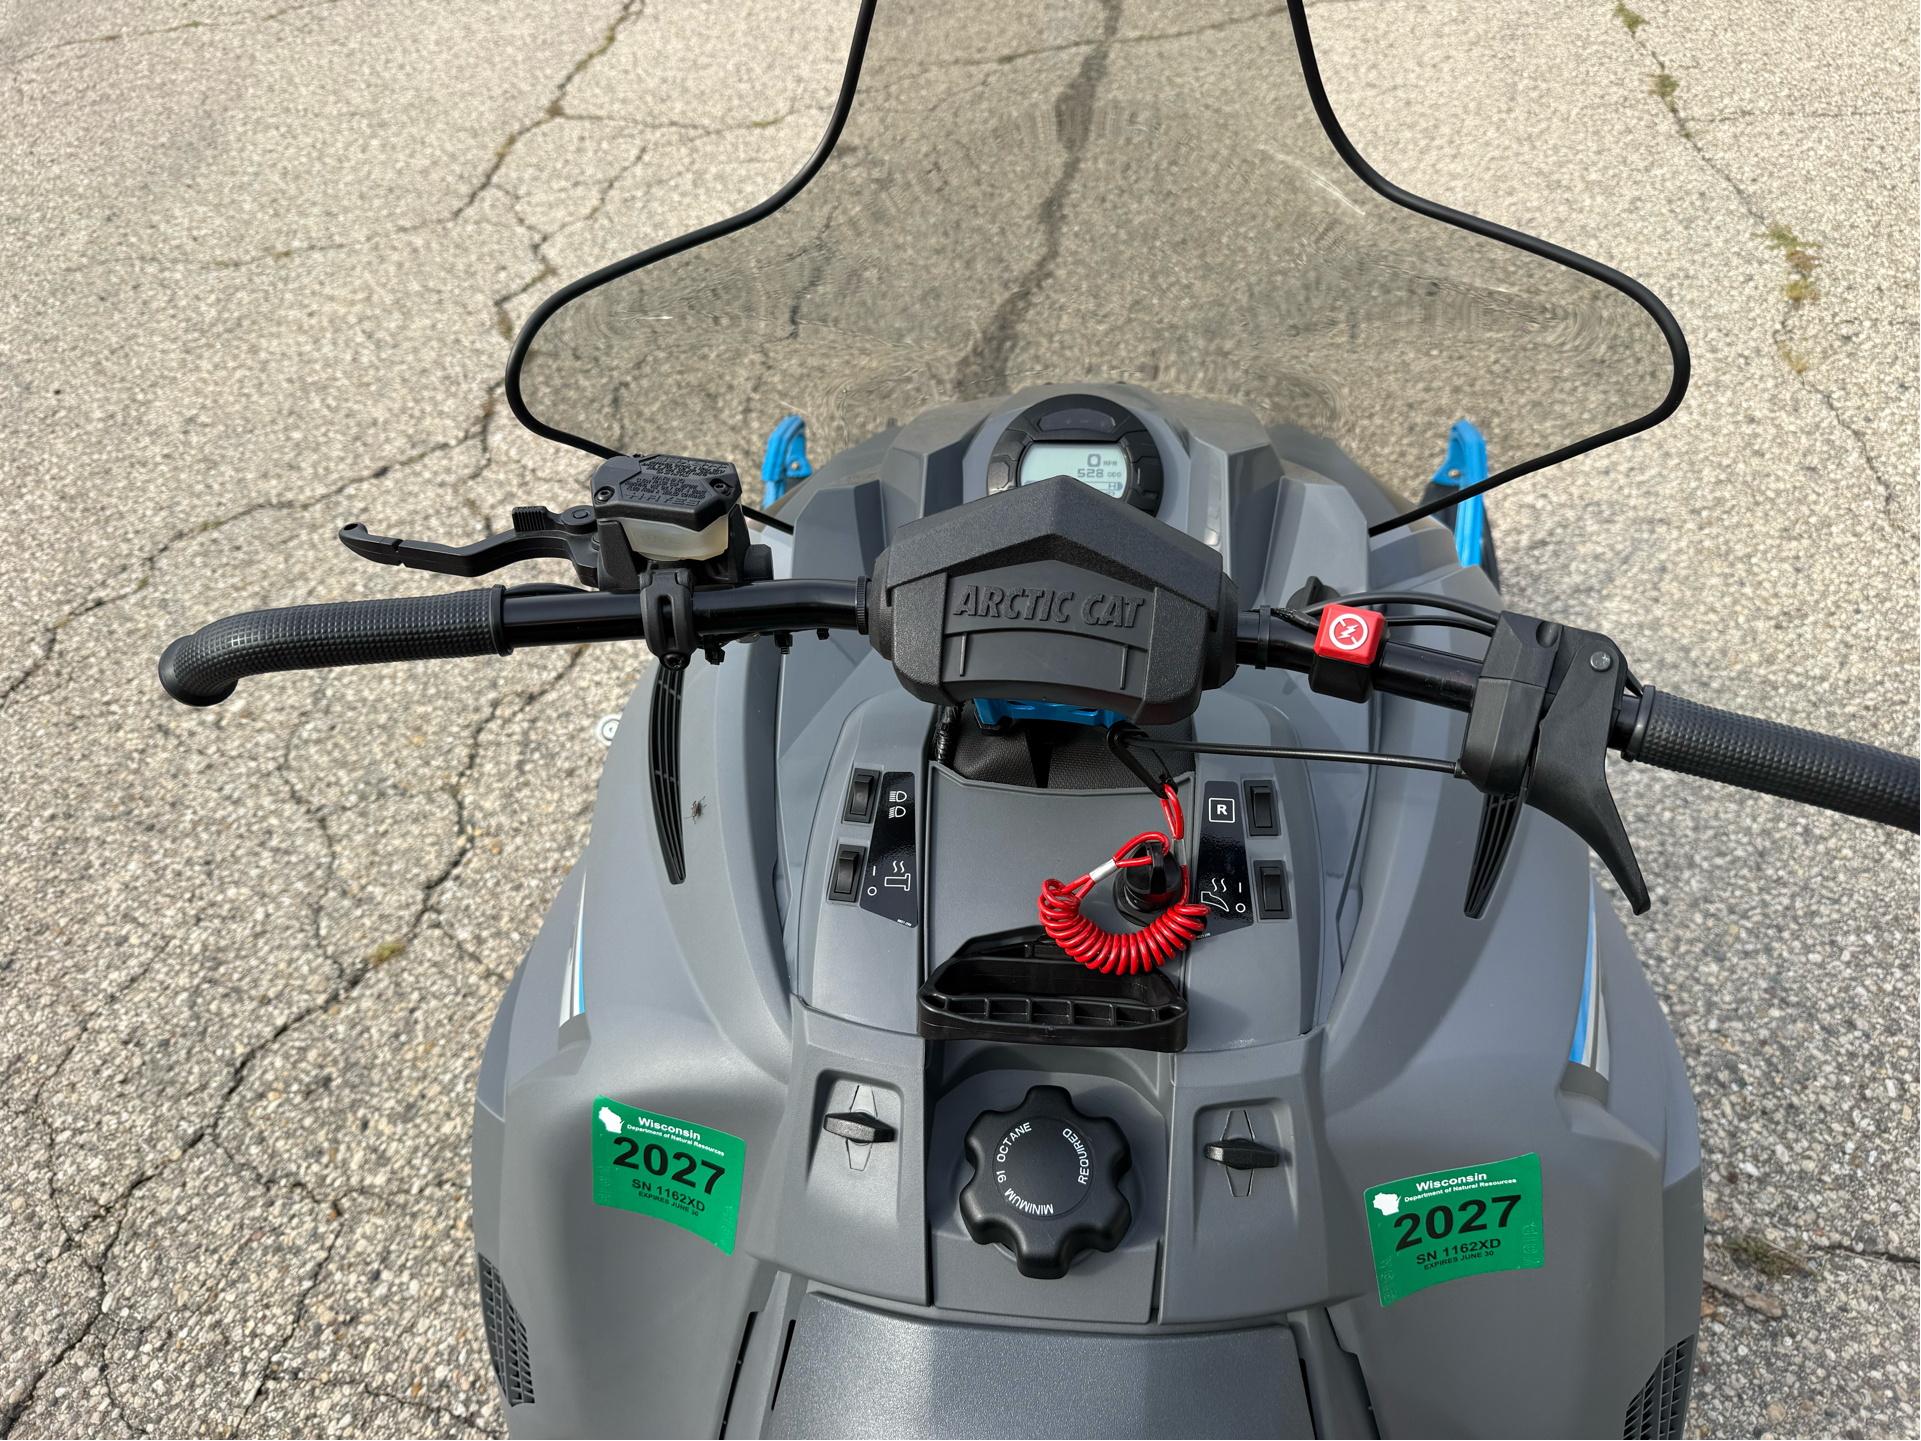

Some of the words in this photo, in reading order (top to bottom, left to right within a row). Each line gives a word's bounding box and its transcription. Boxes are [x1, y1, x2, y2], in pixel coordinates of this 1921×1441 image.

[1077, 468, 1104, 478] 528
[952, 584, 1075, 623] ARCTIC
[1081, 593, 1145, 628] CAT
[1216, 804, 1228, 815] R
[627, 1123, 663, 1137] Department
[670, 1134, 693, 1146] Natural
[693, 1140, 725, 1157] Resources
[638, 1116, 701, 1141] Wisconsin
[996, 1122, 1032, 1163] OCTANE
[612, 1136, 726, 1196] 2027
[1062, 1128, 1090, 1185] REQUIRED
[632, 1178, 652, 1192] SN
[656, 1185, 706, 1212] 1162XD
[1404, 1189, 1443, 1203] Department
[1452, 1182, 1478, 1192] Natural
[1479, 1178, 1517, 1188] Resources
[1416, 1172, 1487, 1192] Wisconsin
[638, 1190, 670, 1205] EXPIRES
[670, 1200, 690, 1213] JUNE
[691, 1208, 699, 1217] 30
[1004, 1187, 1054, 1215] MINIMUM
[1393, 1194, 1522, 1252] 2027
[1416, 1250, 1438, 1265] SN
[1442, 1238, 1501, 1256] 1162XD
[1423, 1254, 1459, 1271] EXPIRES
[1460, 1251, 1483, 1261] JUNE
